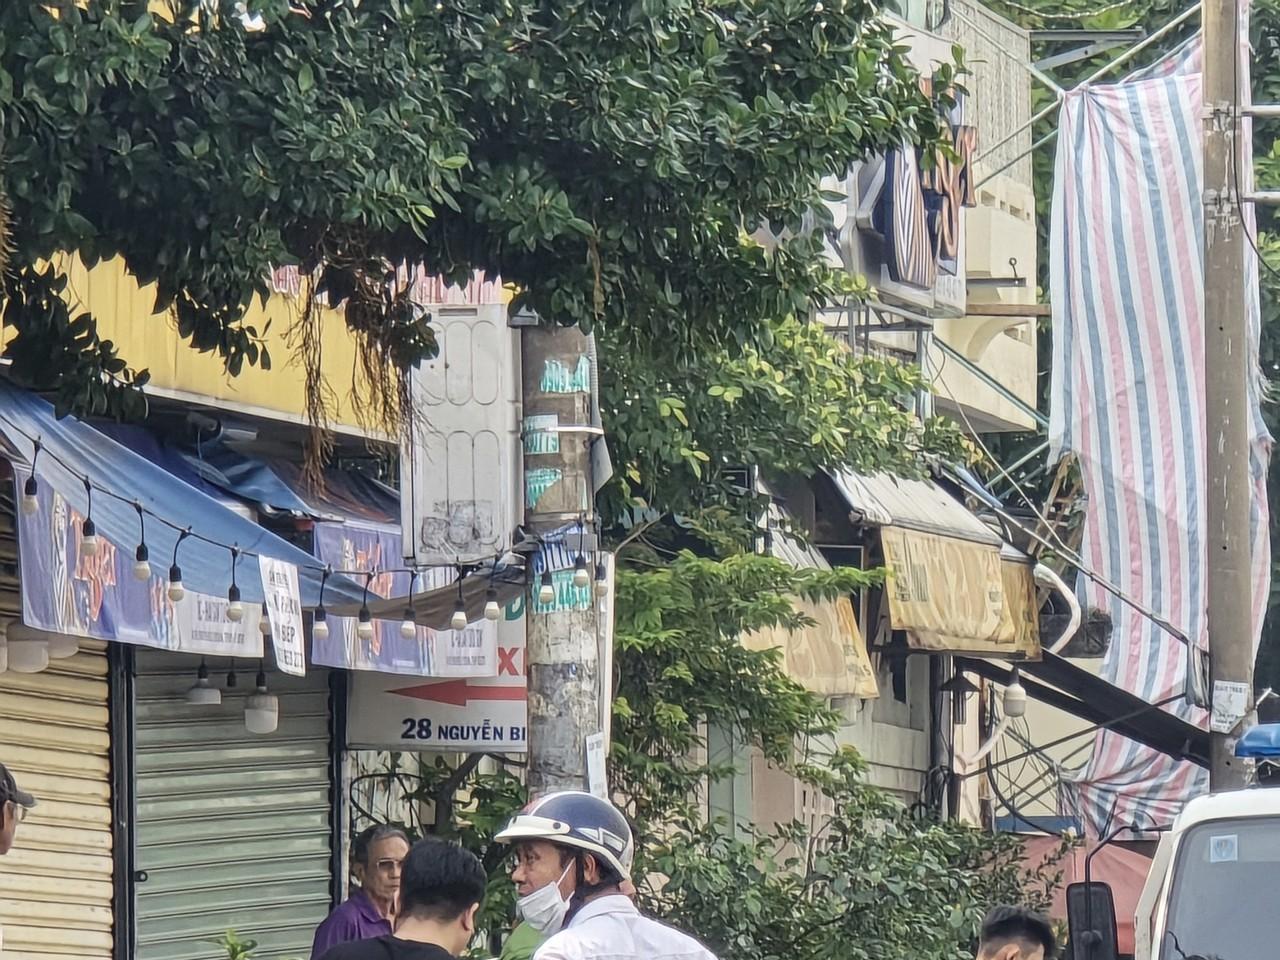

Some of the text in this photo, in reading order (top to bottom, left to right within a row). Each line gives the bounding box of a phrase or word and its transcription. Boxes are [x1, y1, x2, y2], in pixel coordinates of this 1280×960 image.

[497, 647, 527, 676] X
[401, 718, 432, 740] 28
[437, 719, 504, 741] NGUYỄN
